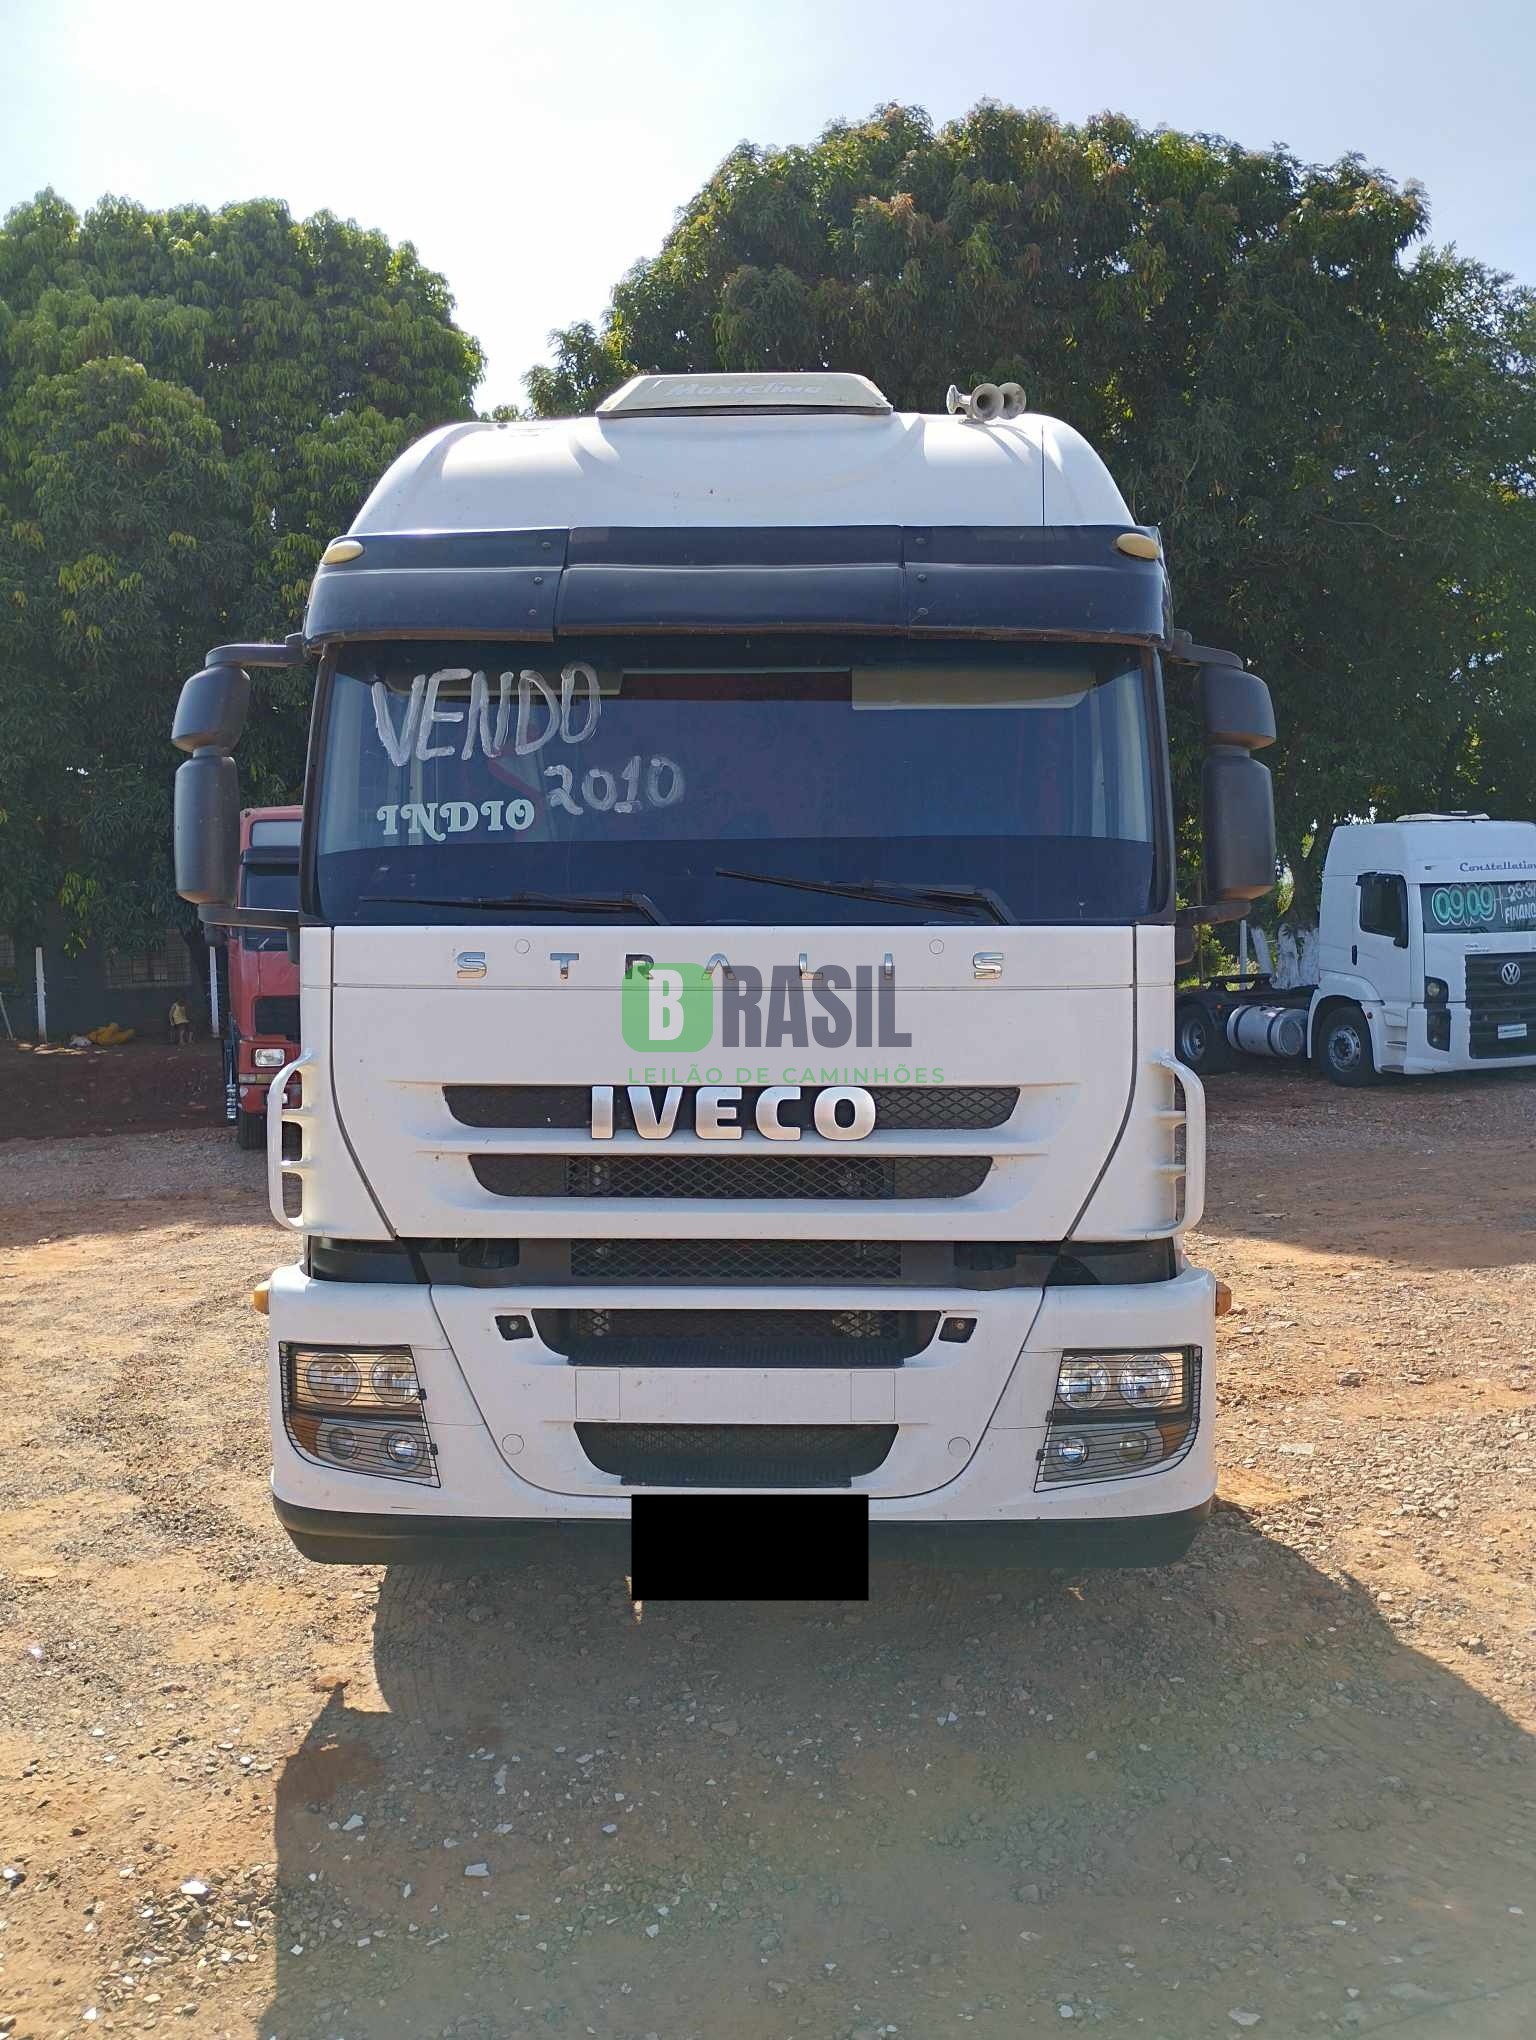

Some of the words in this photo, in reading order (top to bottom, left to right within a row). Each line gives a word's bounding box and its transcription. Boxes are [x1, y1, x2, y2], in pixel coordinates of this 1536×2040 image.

[371, 662, 601, 767] VENDO
[544, 754, 686, 816] 2010
[376, 799, 536, 842] INDIO
[456, 951, 1004, 981] STRALIS
[590, 1085, 877, 1141] IVECO
